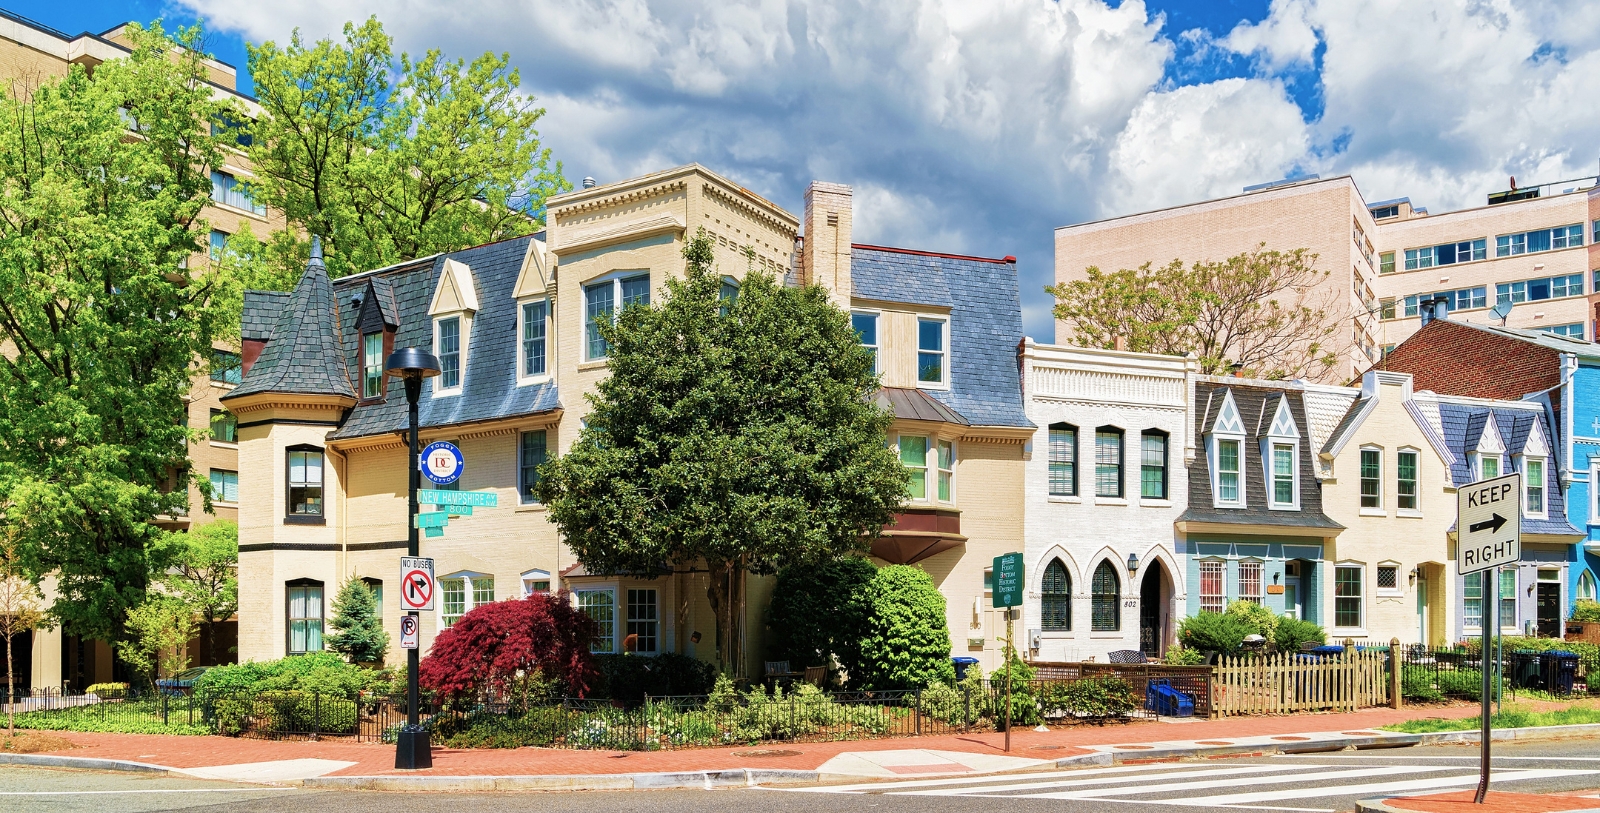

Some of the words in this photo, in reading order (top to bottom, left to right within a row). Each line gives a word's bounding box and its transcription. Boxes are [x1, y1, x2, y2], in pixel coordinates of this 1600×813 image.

[435, 457, 450, 468] DC
[429, 474, 456, 483] BOTTOM
[422, 491, 439, 503] NEW
[442, 492, 484, 505] HAMPSHIRE
[1468, 483, 1511, 508] KEEP
[450, 505, 468, 514] 800
[1465, 540, 1514, 566] RIGHT
[402, 560, 410, 568] NO
[414, 560, 432, 569] BUSES
